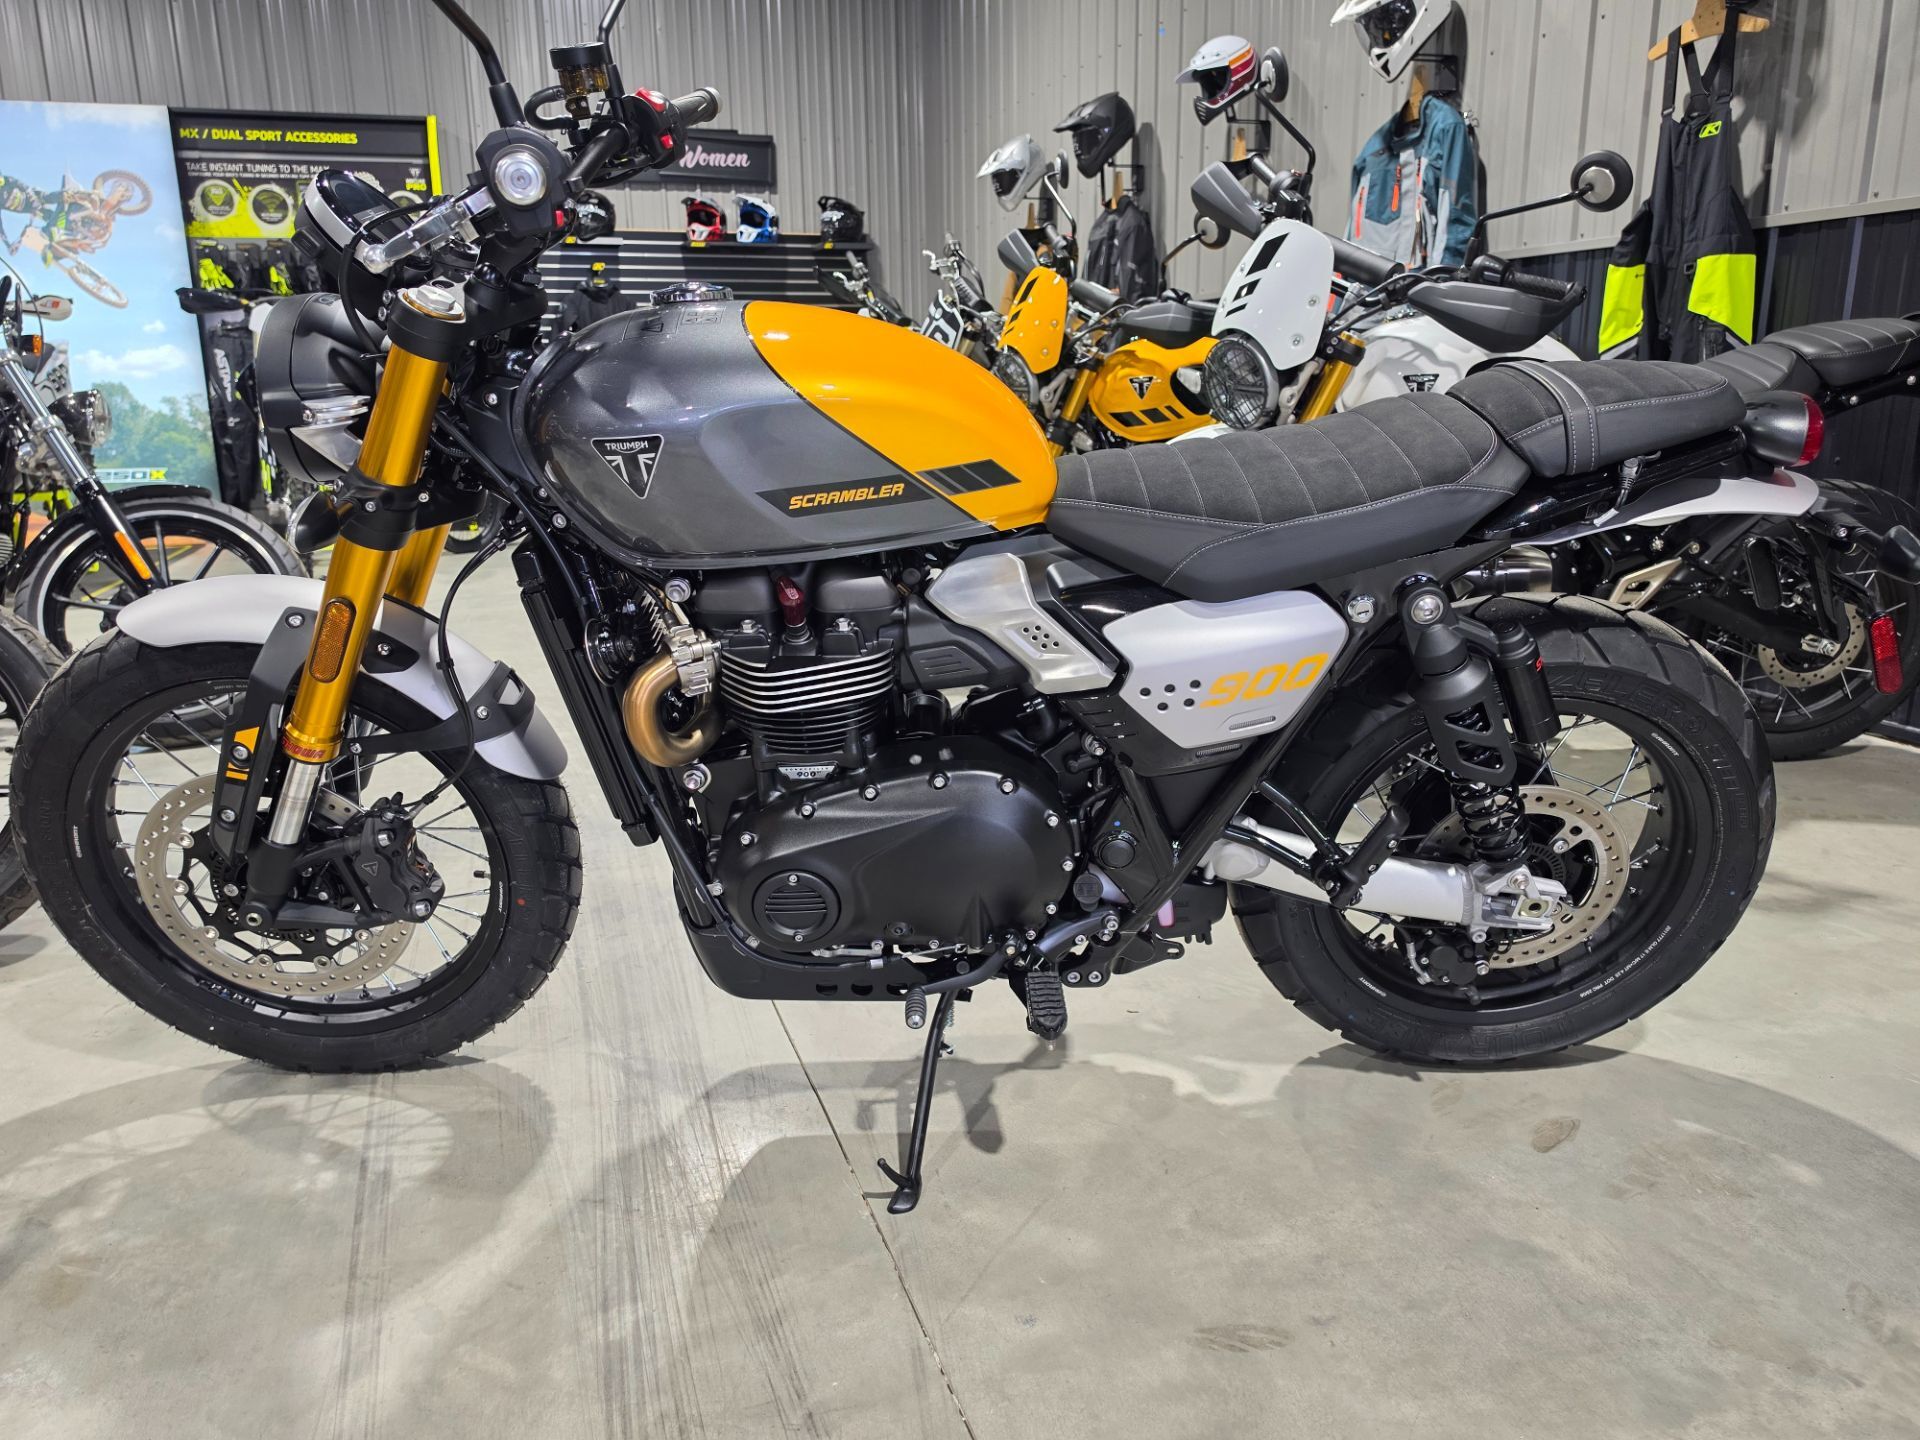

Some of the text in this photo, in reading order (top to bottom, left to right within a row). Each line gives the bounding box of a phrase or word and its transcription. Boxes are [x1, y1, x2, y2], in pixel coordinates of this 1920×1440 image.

[180, 128, 199, 139] MX
[211, 128, 243, 140] DUAL
[245, 129, 282, 141] SPORT
[285, 131, 358, 144] ACCESSORIES
[679, 144, 751, 168] Women
[185, 162, 208, 171] TAKE
[209, 163, 243, 172] INSTANT
[245, 163, 277, 173] TUNING
[279, 164, 291, 173] TO
[292, 164, 309, 174] THE
[604, 440, 649, 452] TRIUMPH
[788, 483, 905, 510] SCRAMBLER
[1199, 653, 1329, 708] 900
